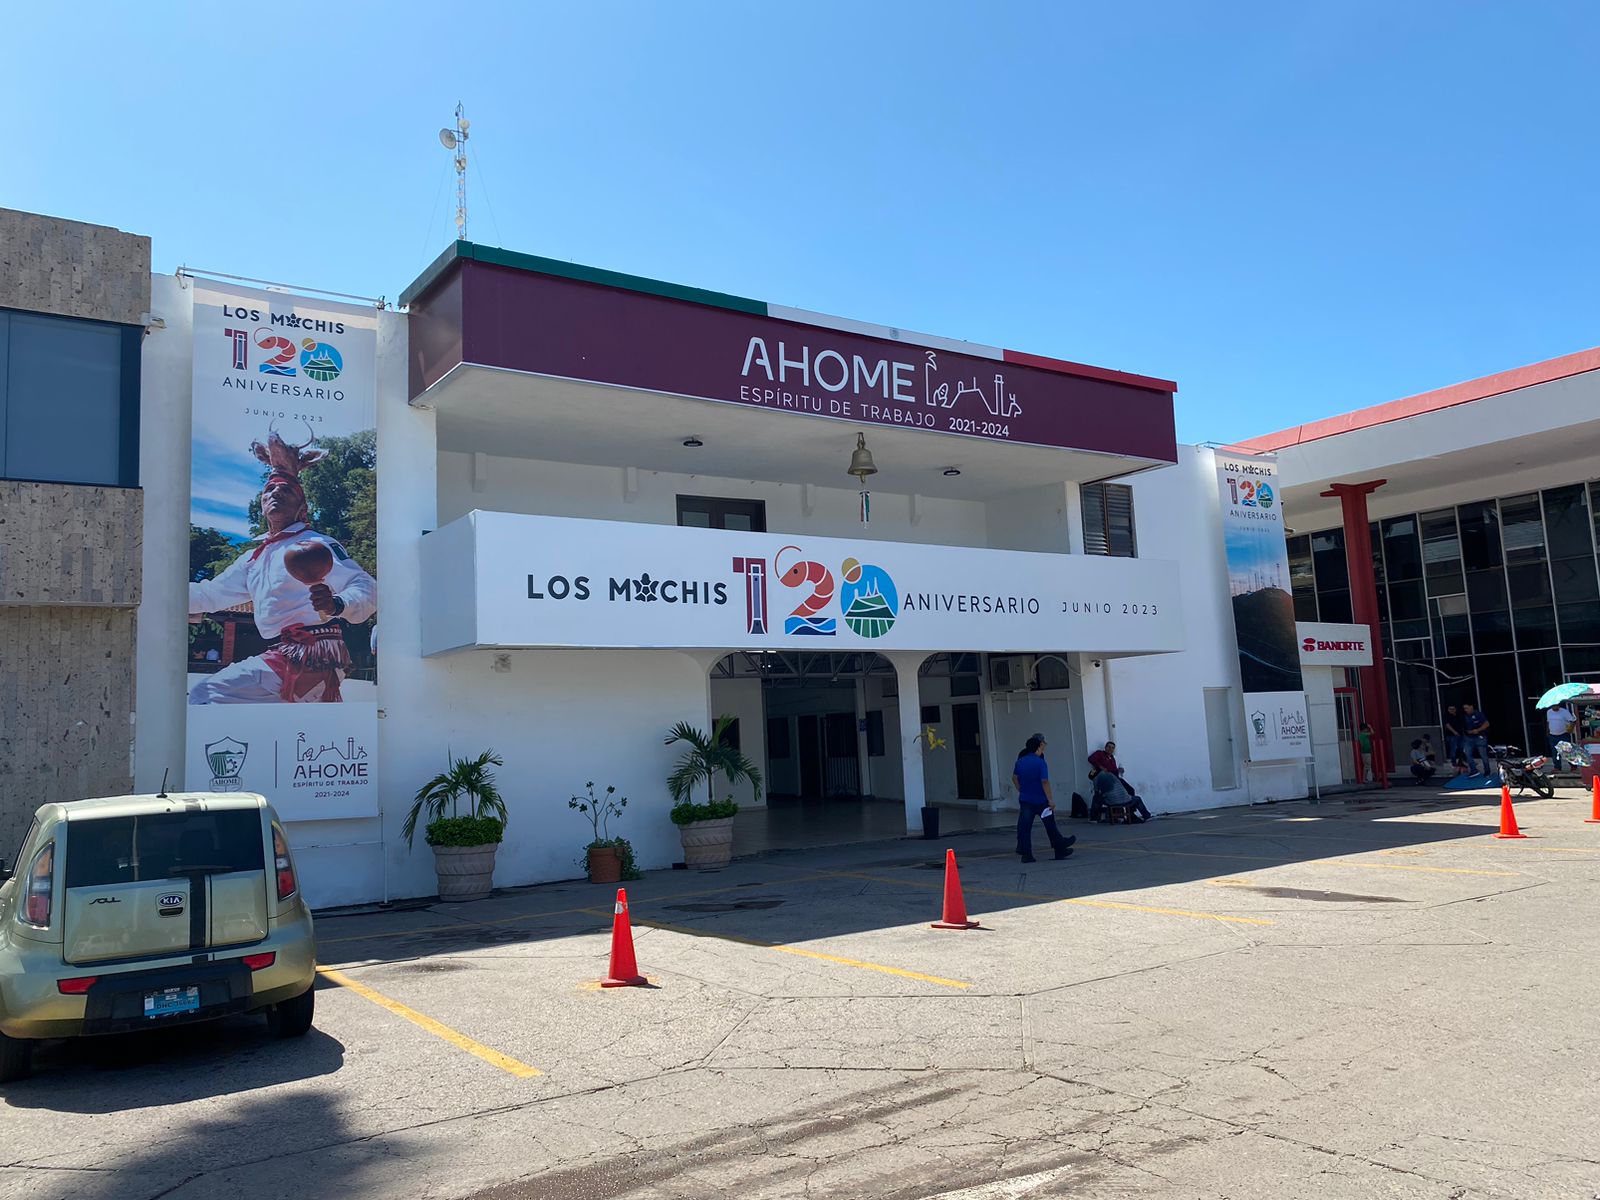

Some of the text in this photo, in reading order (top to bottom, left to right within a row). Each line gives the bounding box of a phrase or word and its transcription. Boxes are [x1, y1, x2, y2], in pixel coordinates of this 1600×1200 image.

[223, 304, 260, 322] LOS
[224, 327, 344, 382] 120
[741, 336, 915, 402] AHOME
[222, 376, 344, 401] ANIVERSARIO
[740, 385, 936, 427] ESPÍRITU DE TRABAJO
[244, 408, 323, 423] JUNIO 2023
[949, 417, 1010, 437] 2021-2024
[1224, 462, 1239, 472] LOS
[1227, 475, 1274, 508] 120
[1230, 509, 1277, 521] ANIVERSARIO
[527, 574, 591, 600] LOS
[732, 545, 899, 639] 120
[904, 593, 1040, 614] ANIVERSARIO
[1062, 602, 1112, 614] JUNIO
[1122, 604, 1158, 615] 2023
[1317, 641, 1365, 651] BANORTE
[1281, 725, 1306, 735] AHOME
[294, 763, 369, 779] AHOME
[337, 779, 369, 787] TRABAJO
[315, 790, 350, 798] 2021-2024
